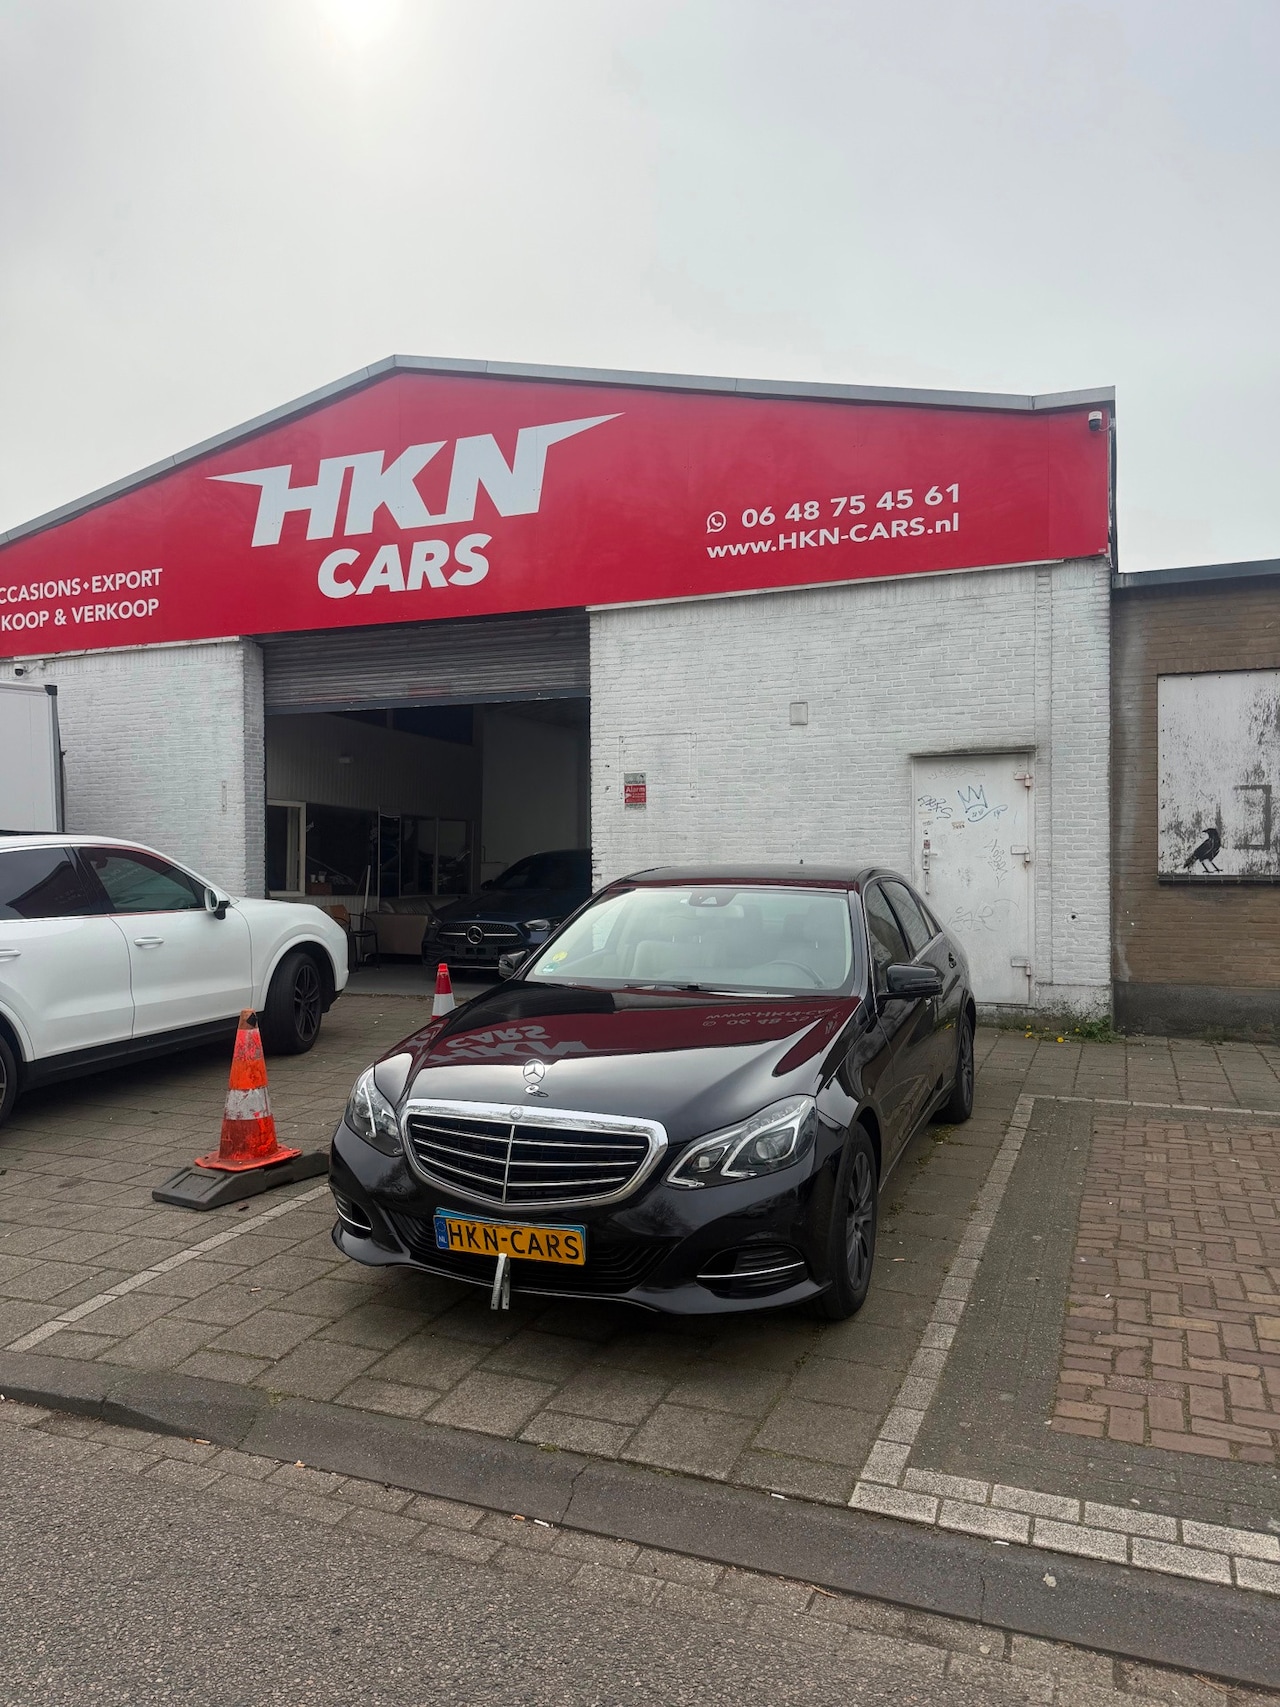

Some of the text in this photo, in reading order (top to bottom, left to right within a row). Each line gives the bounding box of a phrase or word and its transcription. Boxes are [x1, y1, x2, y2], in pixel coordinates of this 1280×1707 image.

[205, 412, 626, 547] HKN
[741, 483, 959, 528] 06 48 75 45 61
[706, 512, 959, 558] www.HKN-CARS.nl
[91, 568, 163, 593] EXPORT
[317, 532, 493, 599] CARS
[54, 608, 67, 626] &
[71, 598, 159, 624] VERKOOP
[448, 1223, 580, 1260] HKN-CARS
